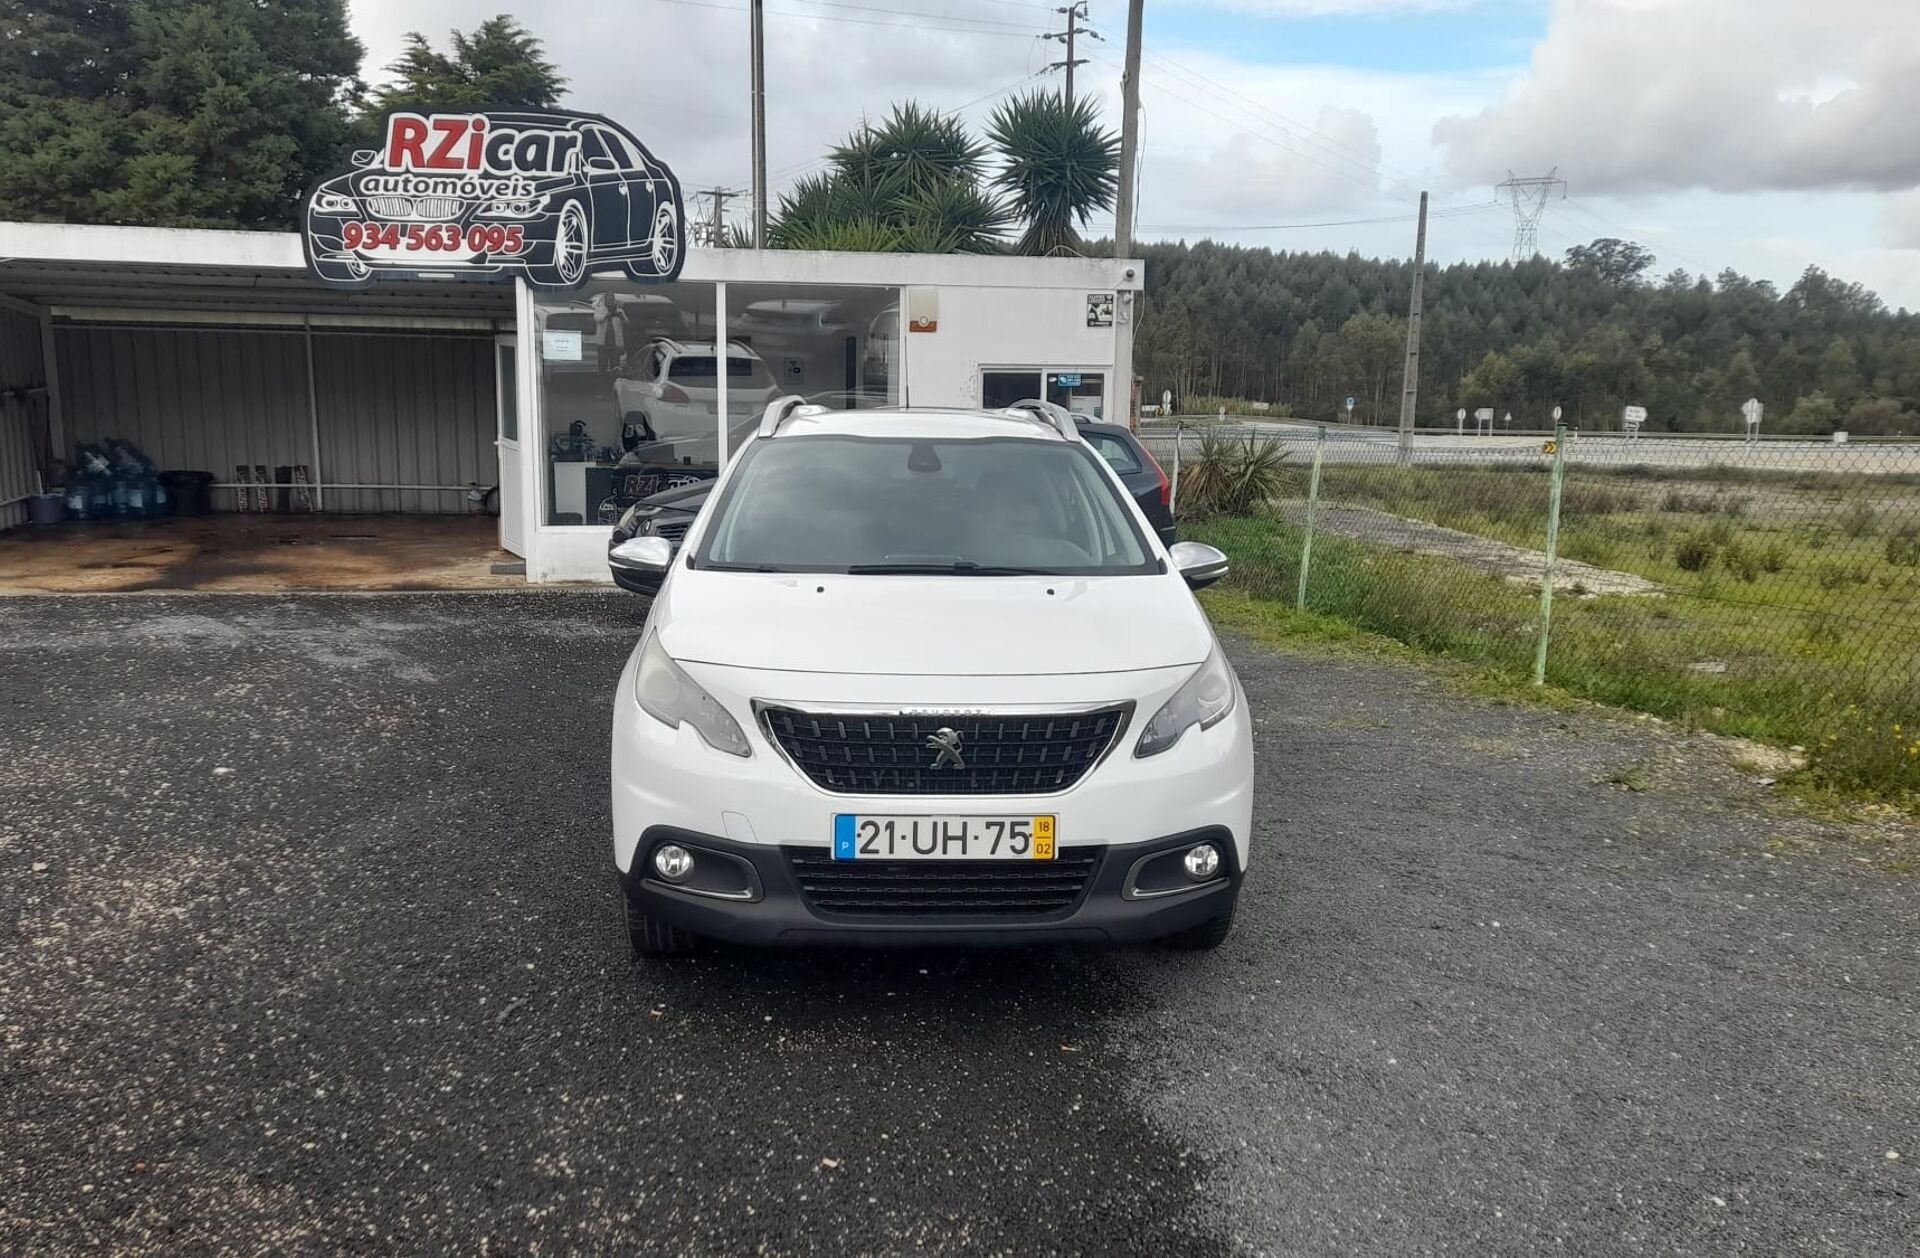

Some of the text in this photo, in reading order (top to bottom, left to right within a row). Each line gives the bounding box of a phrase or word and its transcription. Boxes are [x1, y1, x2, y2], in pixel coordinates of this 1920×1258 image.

[386, 115, 581, 174] RZicar
[362, 173, 535, 198] automóveis
[342, 221, 524, 255] 934 563 095
[841, 841, 850, 850] P
[1038, 821, 1050, 832] 18
[1036, 843, 1051, 854] 02
